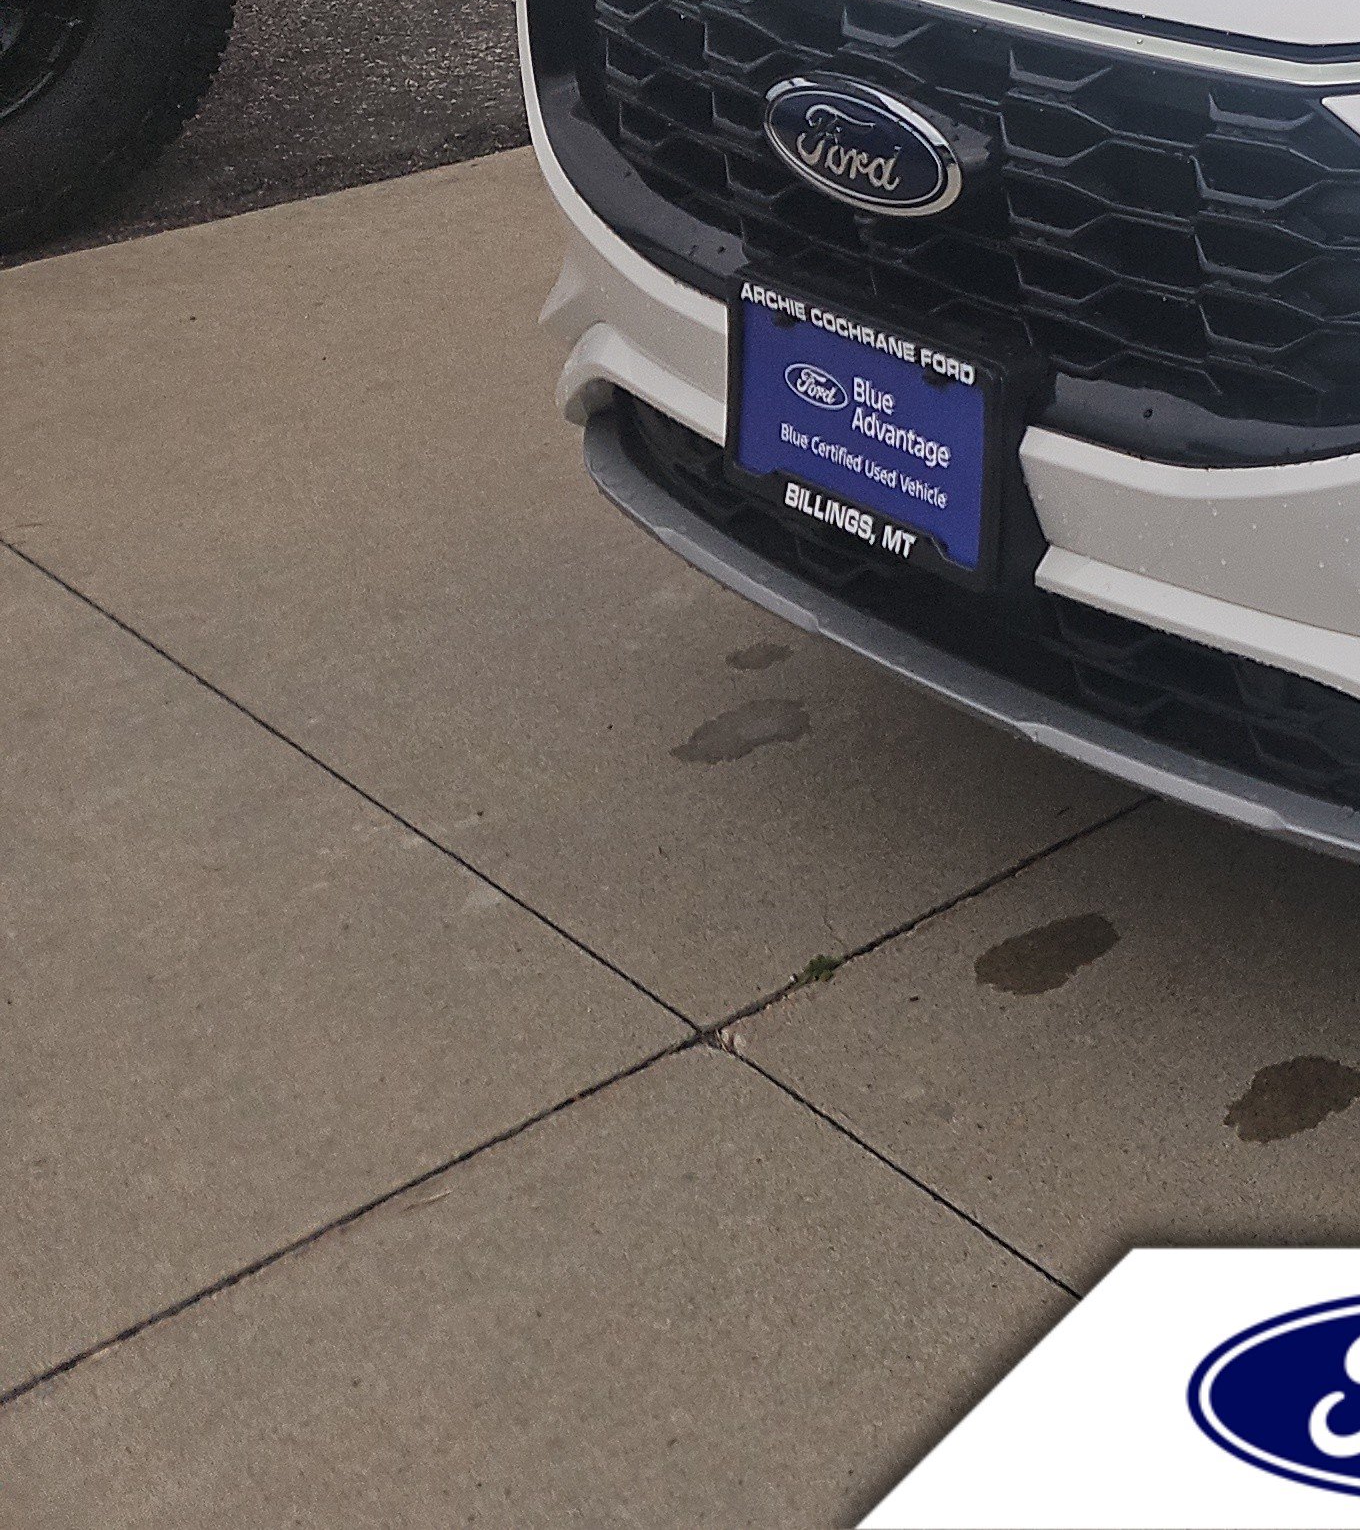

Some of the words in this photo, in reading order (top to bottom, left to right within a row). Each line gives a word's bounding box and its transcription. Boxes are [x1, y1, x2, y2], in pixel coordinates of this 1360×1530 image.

[796, 103, 901, 191] Ford
[740, 281, 807, 321] ARCHIE
[810, 307, 916, 363] COCHRANE
[920, 347, 974, 386] FORD
[796, 368, 837, 405] Ford
[853, 376, 895, 415] Blue
[780, 422, 809, 450] Blue
[811, 436, 863, 473] Certified
[864, 459, 897, 489] Used
[899, 473, 949, 509] Vehicle
[851, 406, 952, 469] Advantage
[784, 482, 876, 546] BILLINGS,
[881, 524, 918, 559] MT
